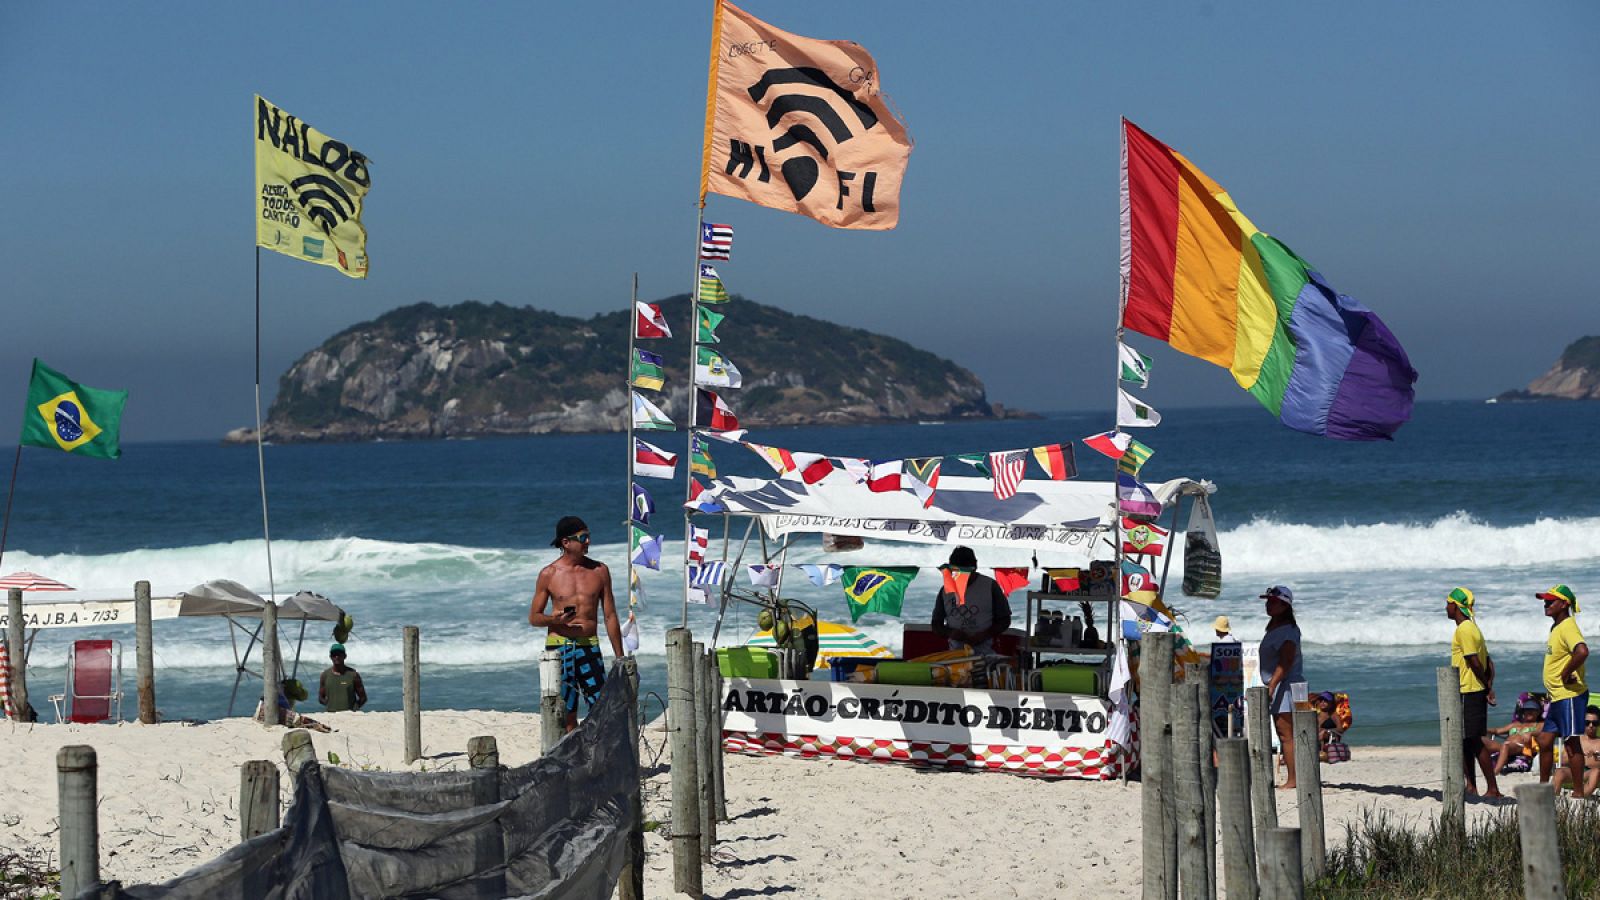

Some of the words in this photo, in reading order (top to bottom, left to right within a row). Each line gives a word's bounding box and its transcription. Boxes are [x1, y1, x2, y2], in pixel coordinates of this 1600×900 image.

[836, 170, 877, 212] FI
[908, 521, 946, 539] DA
[92, 609, 119, 622] 7/33
